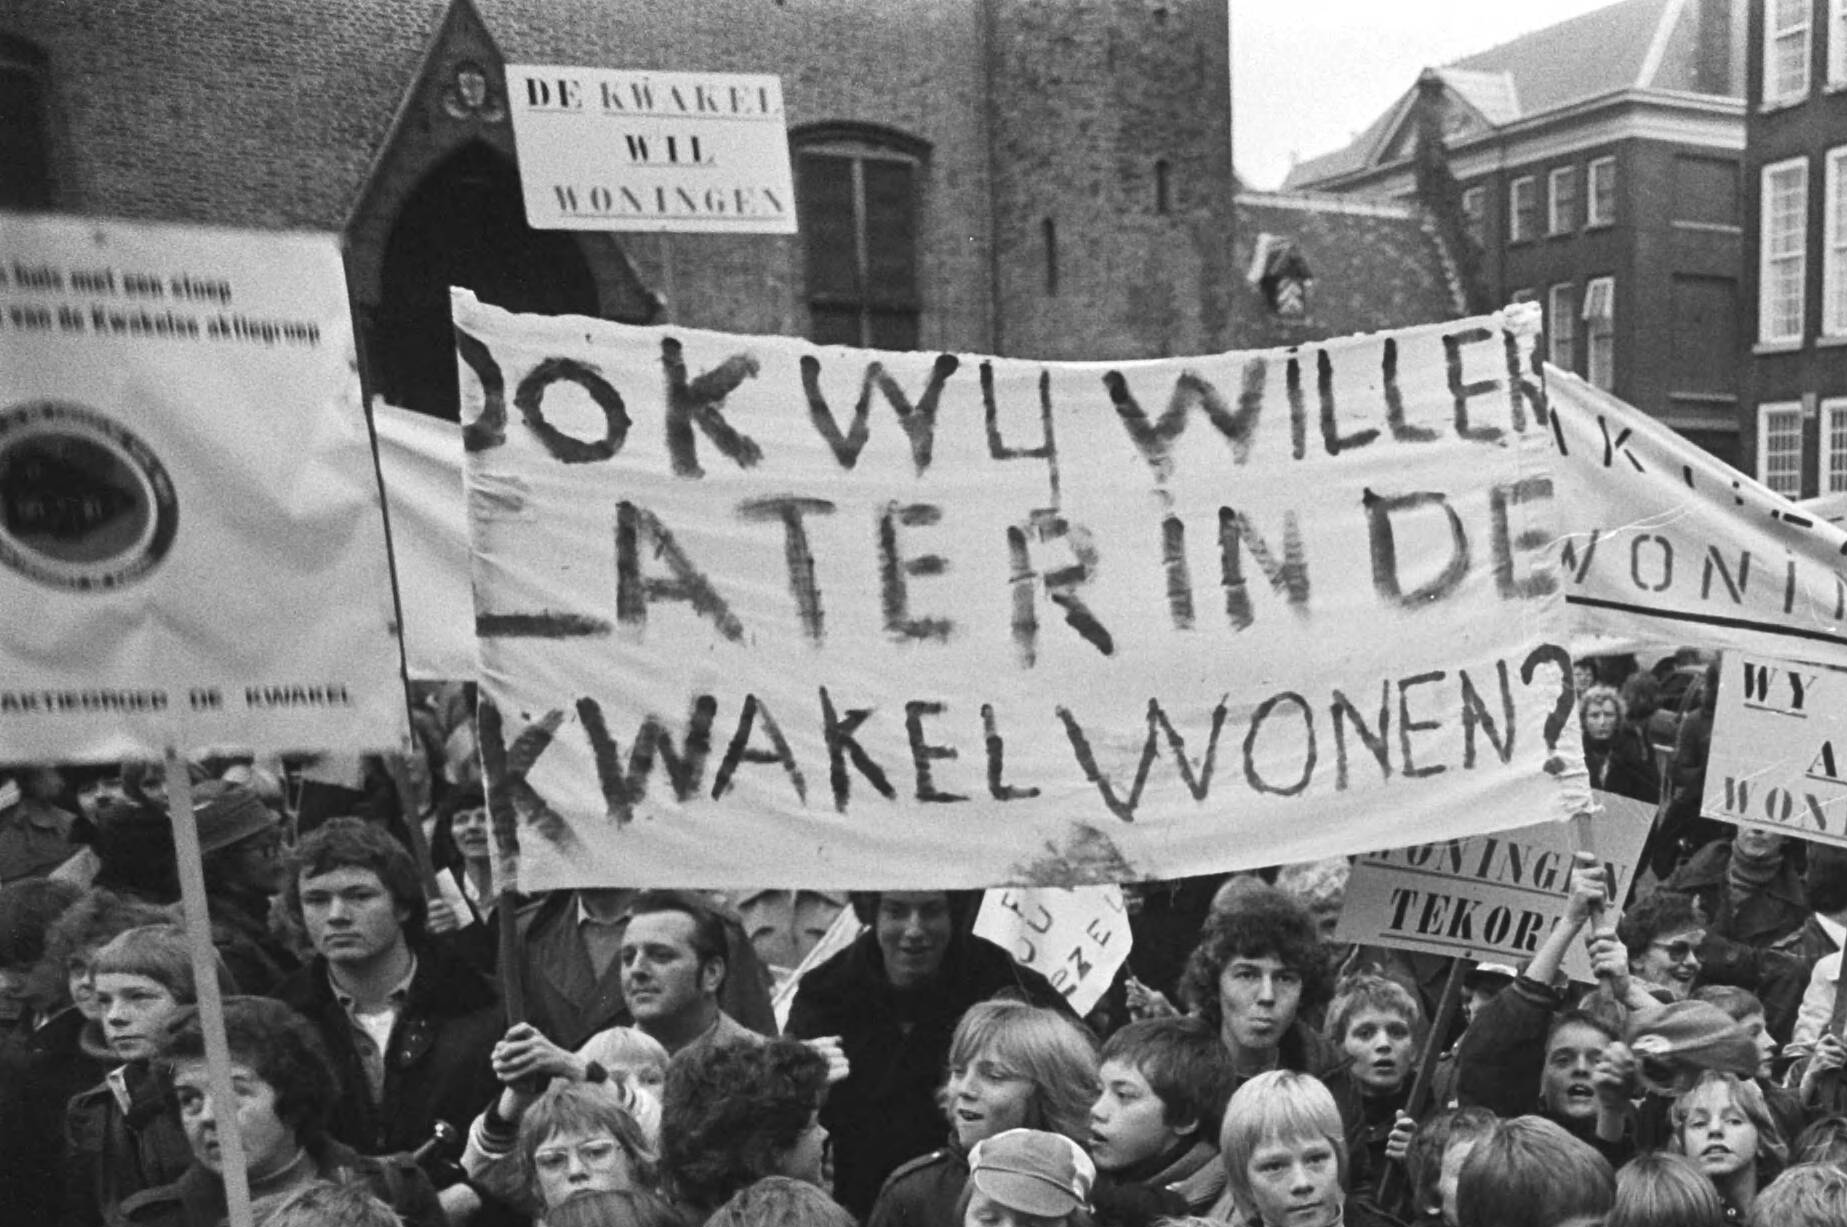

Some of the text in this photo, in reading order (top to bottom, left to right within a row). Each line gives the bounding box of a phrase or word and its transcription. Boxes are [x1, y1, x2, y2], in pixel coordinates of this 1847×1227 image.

[525, 77, 784, 114] DE KWAKEL
[624, 133, 716, 164] WIL
[553, 184, 785, 214] WONINGEN
[1103, 327, 1549, 472] WILLEN
[1162, 503, 1311, 634] IN
[1362, 476, 1562, 612] DE
[1743, 661, 1819, 710] WY
[478, 642, 1576, 882] KWAKEL WONEN?
